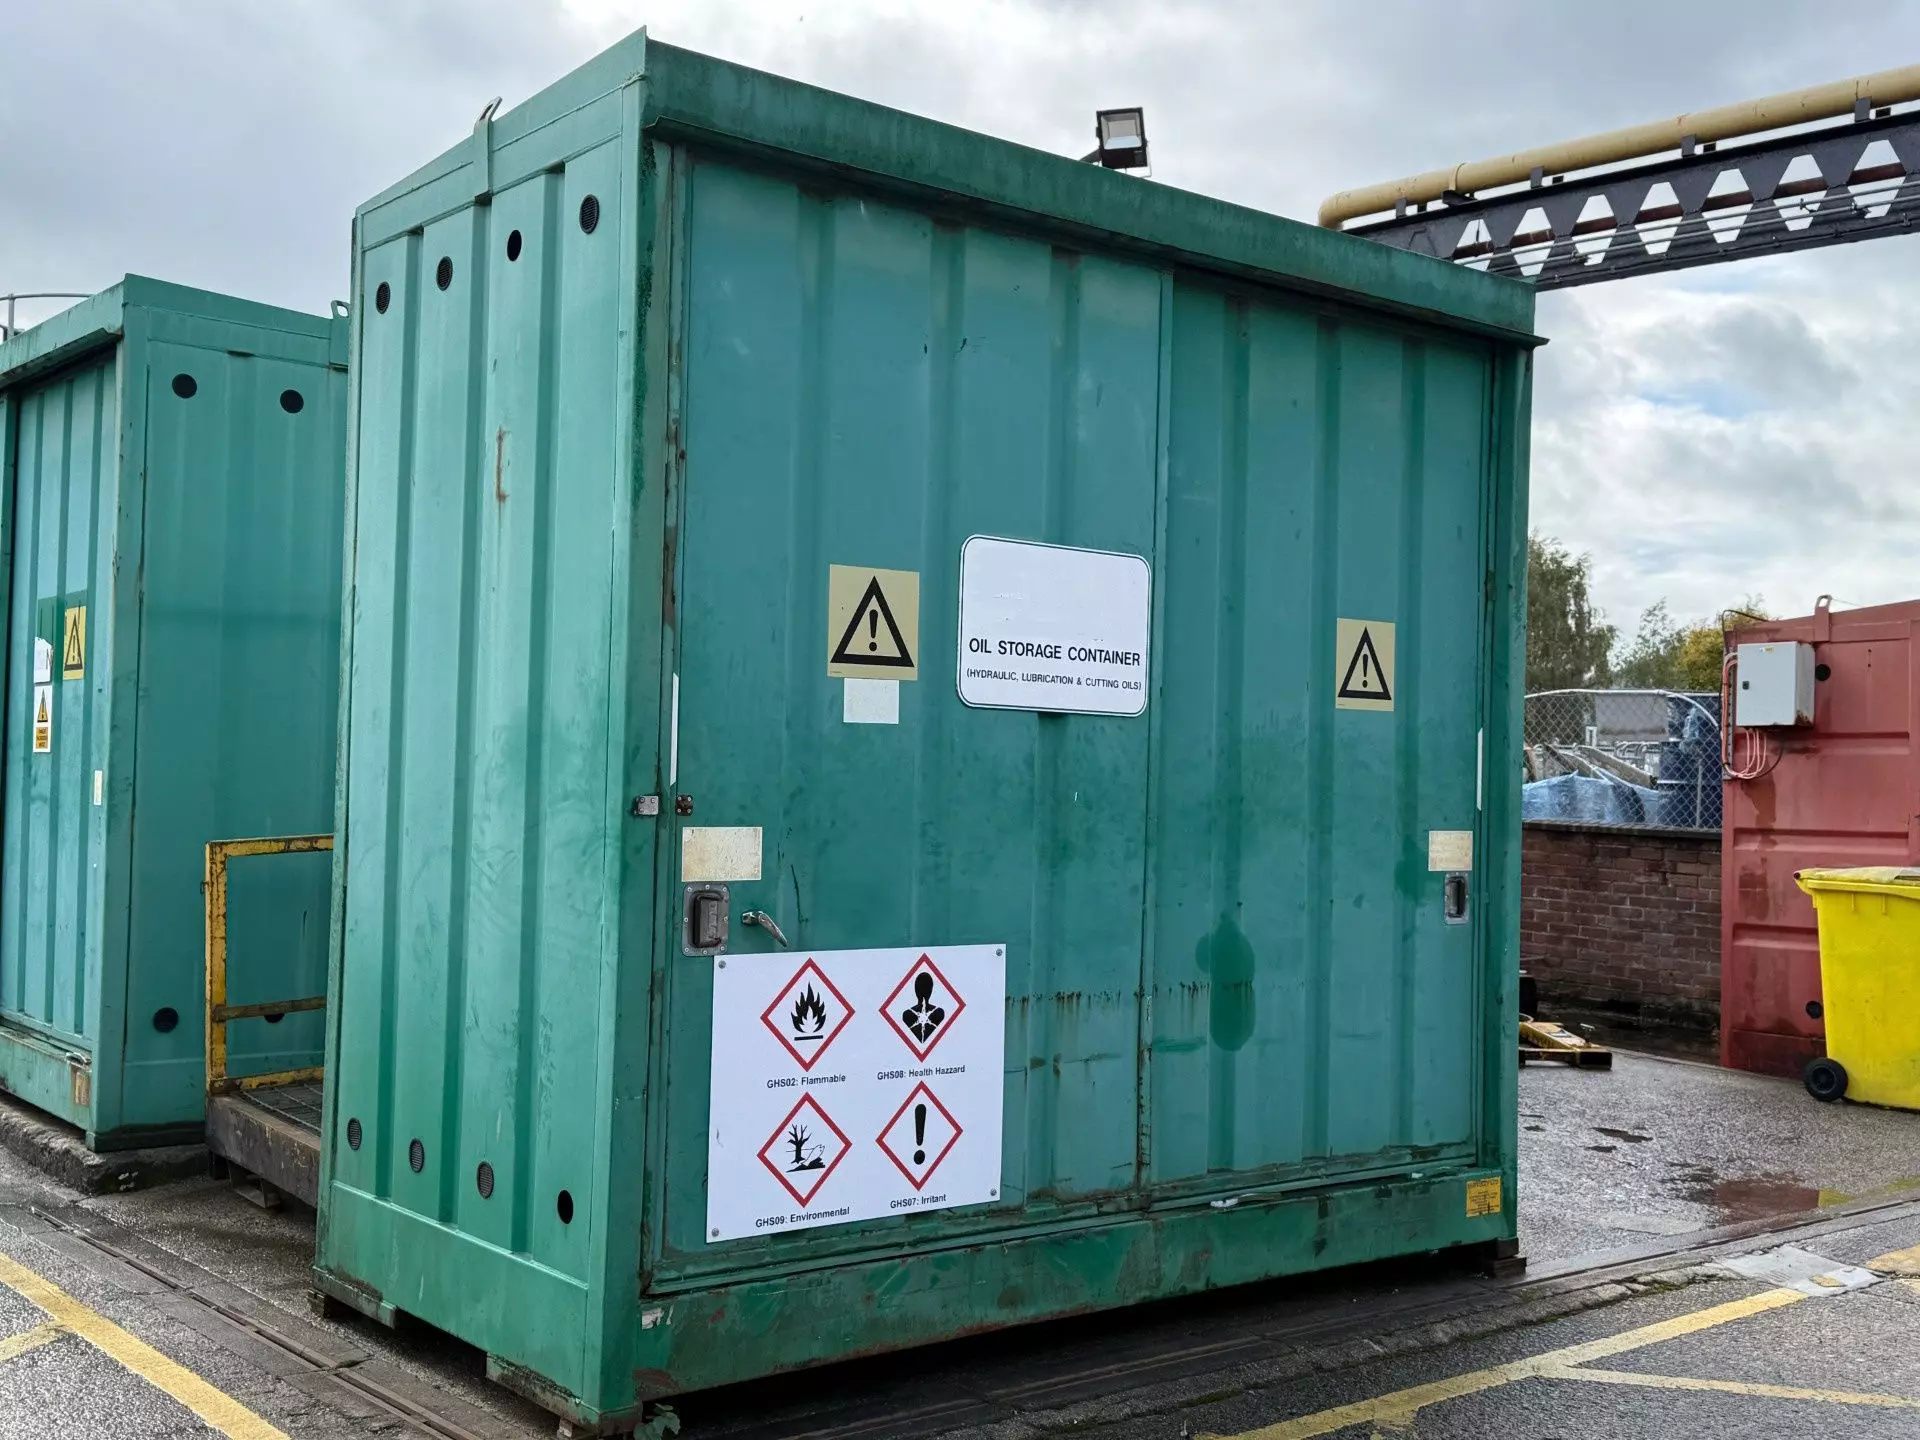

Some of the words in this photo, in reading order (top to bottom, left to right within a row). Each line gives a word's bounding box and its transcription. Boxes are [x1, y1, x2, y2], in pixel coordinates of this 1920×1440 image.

[969, 637, 992, 654] OIL
[997, 640, 1062, 660] STORAGE
[1067, 646, 1141, 667] CONTAINER
[966, 668, 1019, 682] (HYDRAULIC,
[1021, 672, 1074, 685] LUBRICATION
[1076, 676, 1082, 686] &
[1085, 677, 1119, 689] CUTTING
[1121, 680, 1142, 691] OILS)
[766, 1077, 799, 1089] GHS02:
[801, 1073, 846, 1086] Flammable
[877, 1070, 907, 1081] GHS08:
[908, 1067, 933, 1078] Health
[935, 1065, 966, 1076] Hazzard
[890, 1197, 919, 1209] GHS07:
[921, 1194, 947, 1206] Irritant
[755, 1216, 788, 1228] GHS09:
[790, 1206, 850, 1223] Environmental
